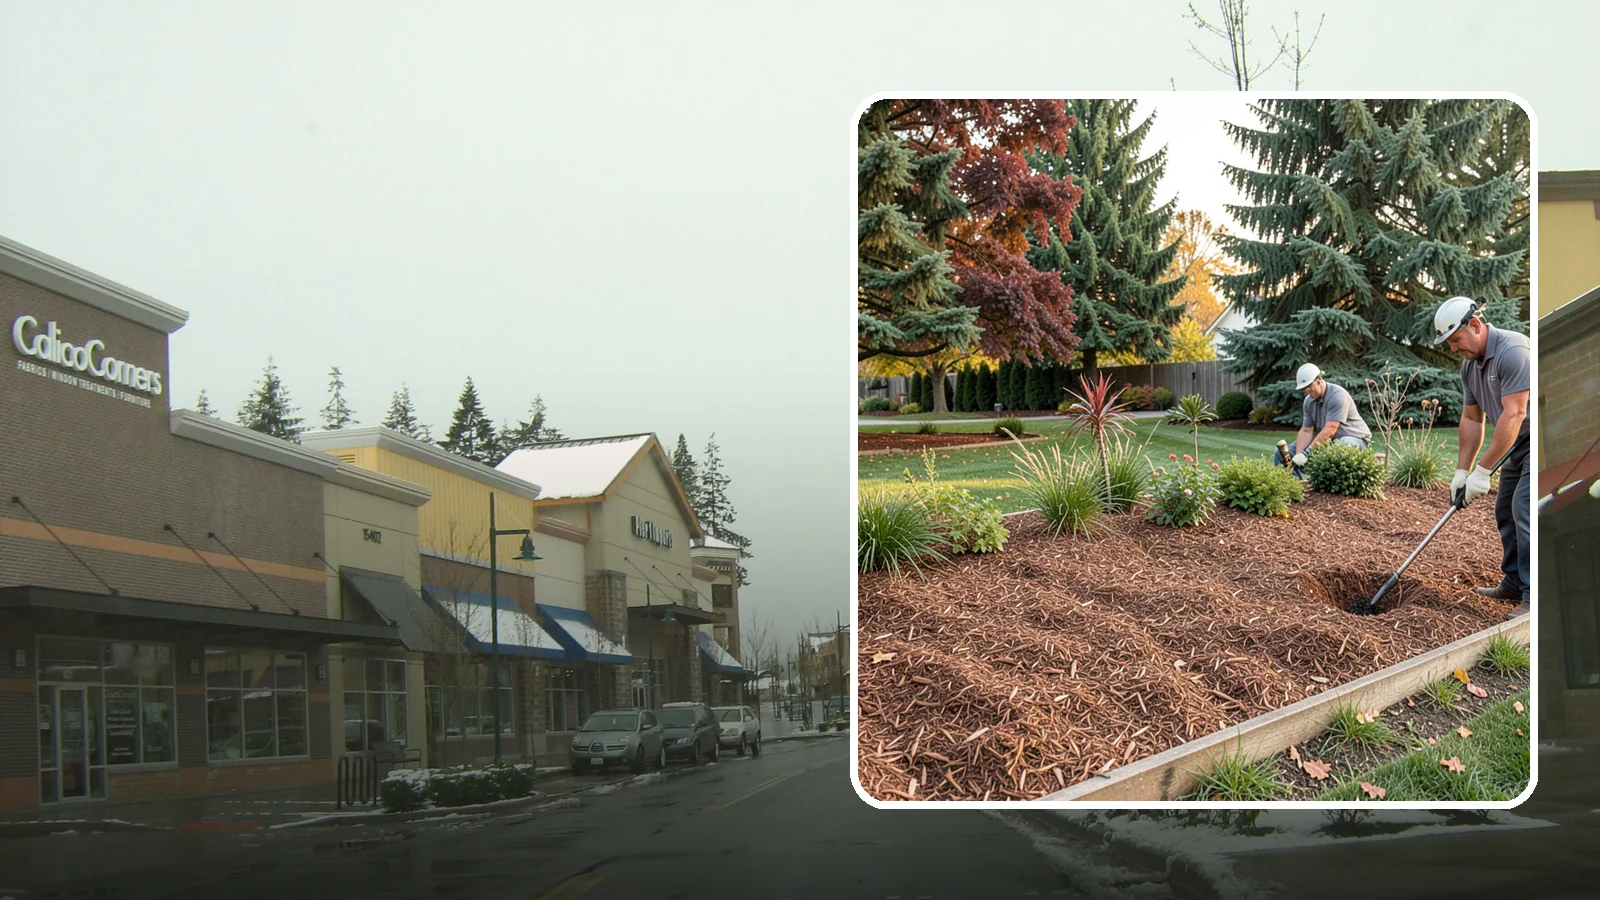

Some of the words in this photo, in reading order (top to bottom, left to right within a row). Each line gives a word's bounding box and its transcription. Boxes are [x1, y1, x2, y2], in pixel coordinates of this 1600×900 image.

[17, 360, 46, 377] FABRICS
[52, 370, 78, 386] WINDOW
[79, 378, 116, 398] TREATMENTS
